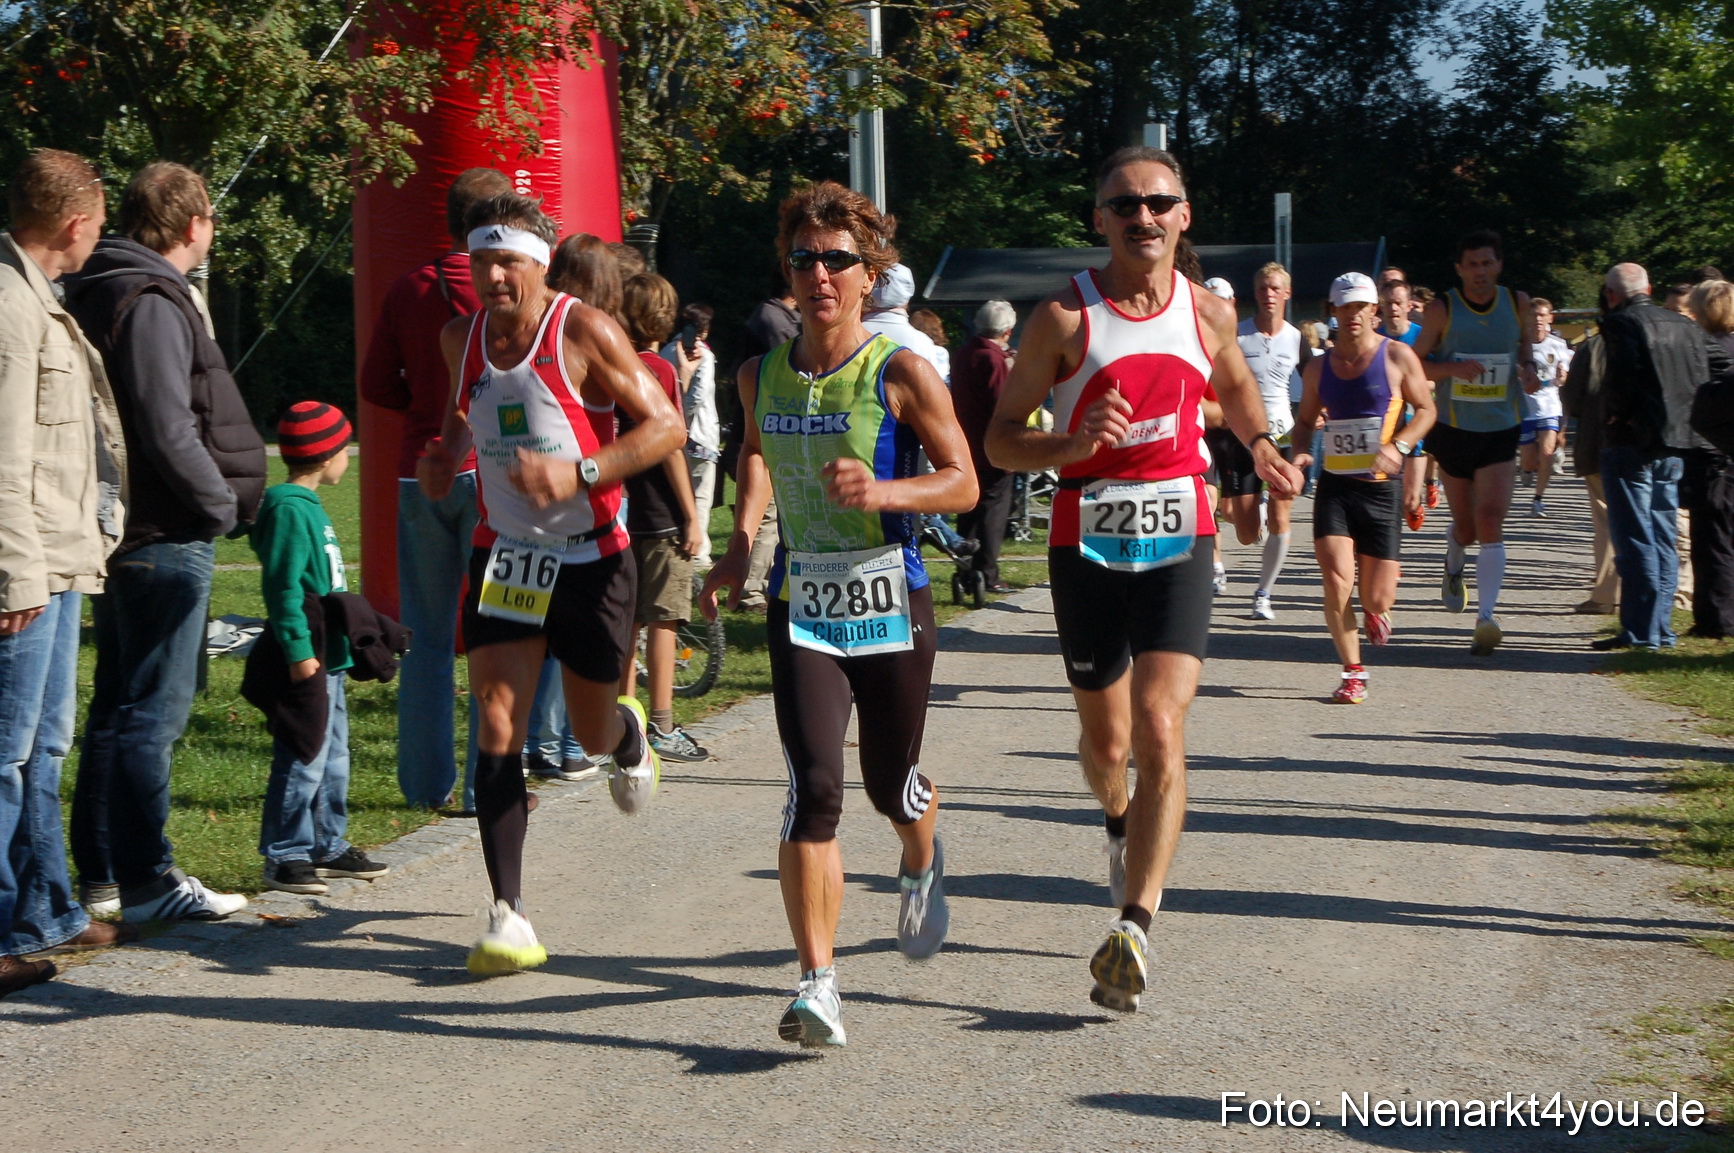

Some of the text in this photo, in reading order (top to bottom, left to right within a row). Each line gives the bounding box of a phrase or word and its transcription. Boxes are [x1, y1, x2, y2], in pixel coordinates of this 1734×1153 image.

[763, 413, 850, 434] BOCK
[1334, 433, 1368, 454] 934
[1094, 499, 1182, 535] 2255
[1119, 537, 1157, 558] Karl
[493, 547, 558, 588] 516
[801, 562, 849, 573] PFLEIDERER
[502, 587, 536, 609] Leo
[801, 576, 894, 619] 3280
[812, 619, 888, 643] Claudia
